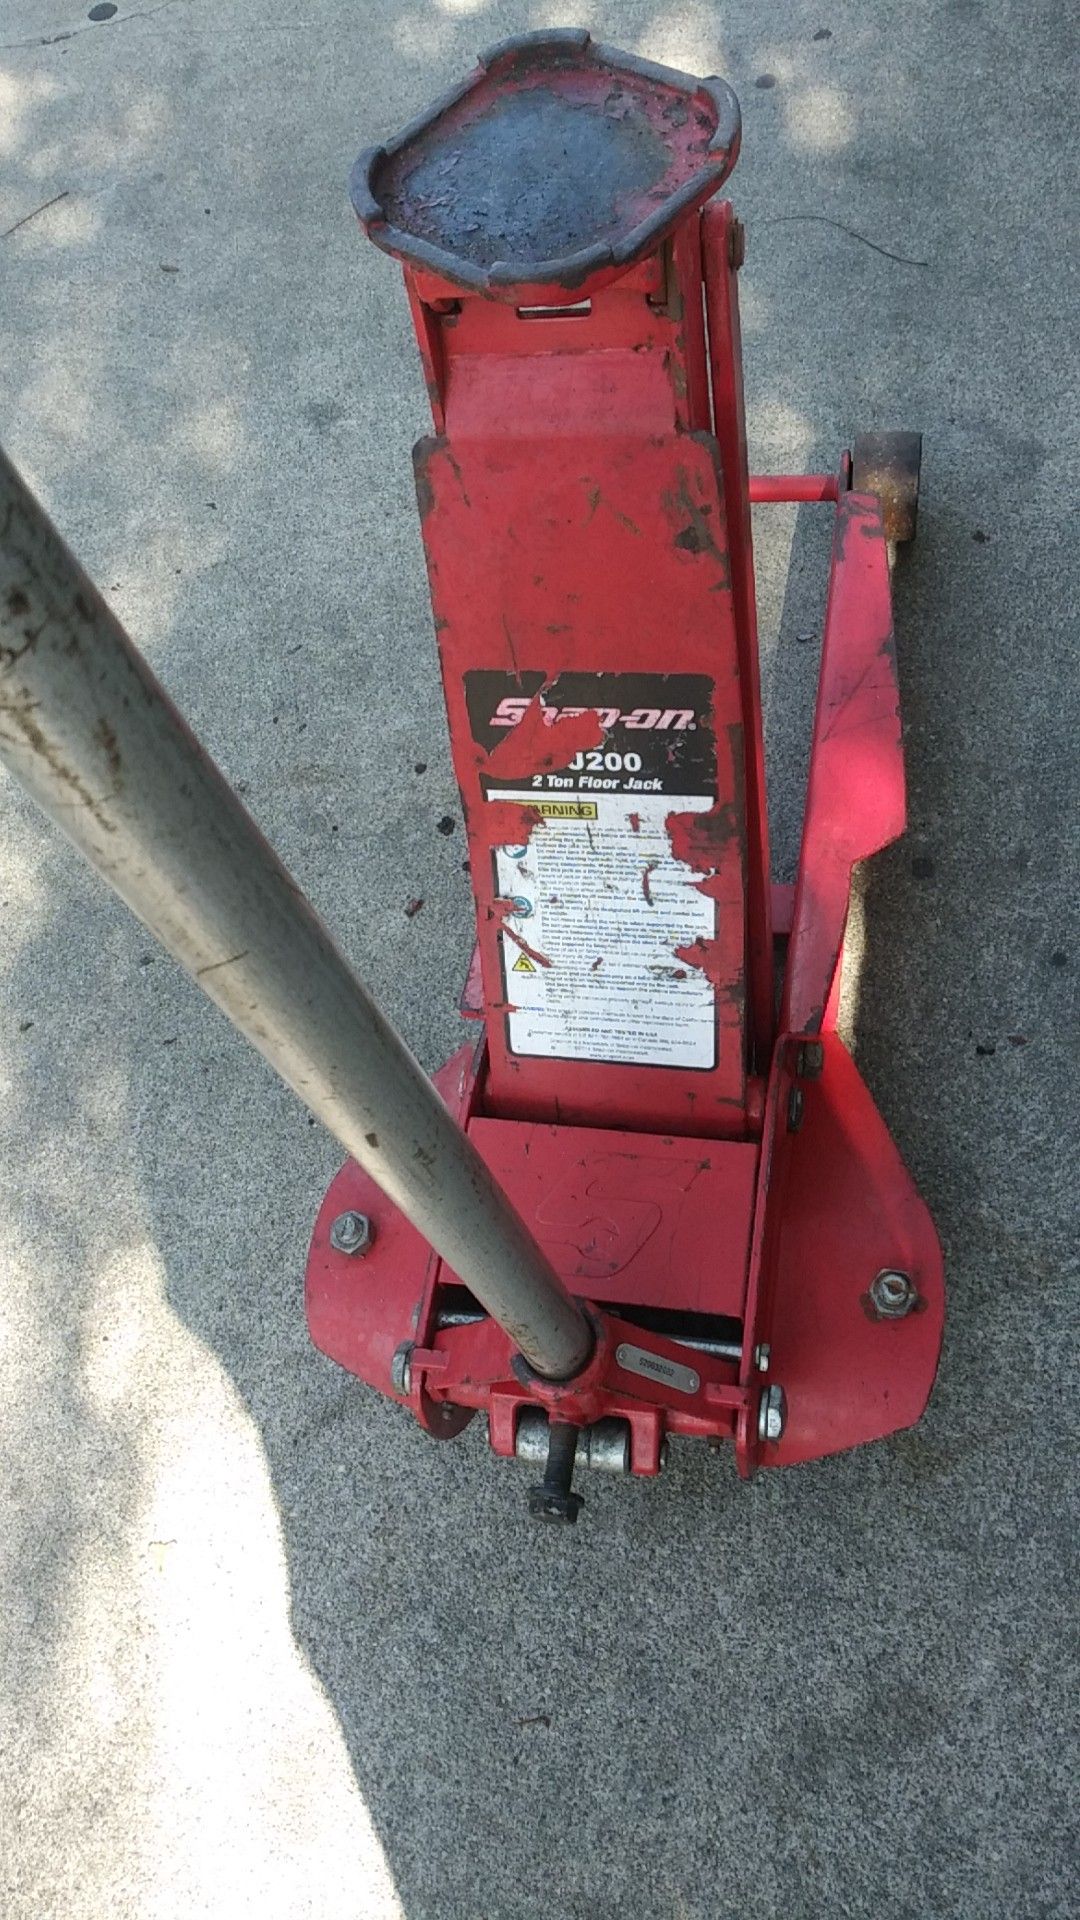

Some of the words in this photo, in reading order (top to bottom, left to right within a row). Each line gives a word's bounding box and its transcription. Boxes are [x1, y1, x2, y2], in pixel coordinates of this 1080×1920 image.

[532, 775, 543, 788] 2
[546, 775, 574, 788] Ton
[579, 776, 620, 790] Floor
[623, 777, 663, 791] Jack
[528, 804, 592, 816] ARNING
